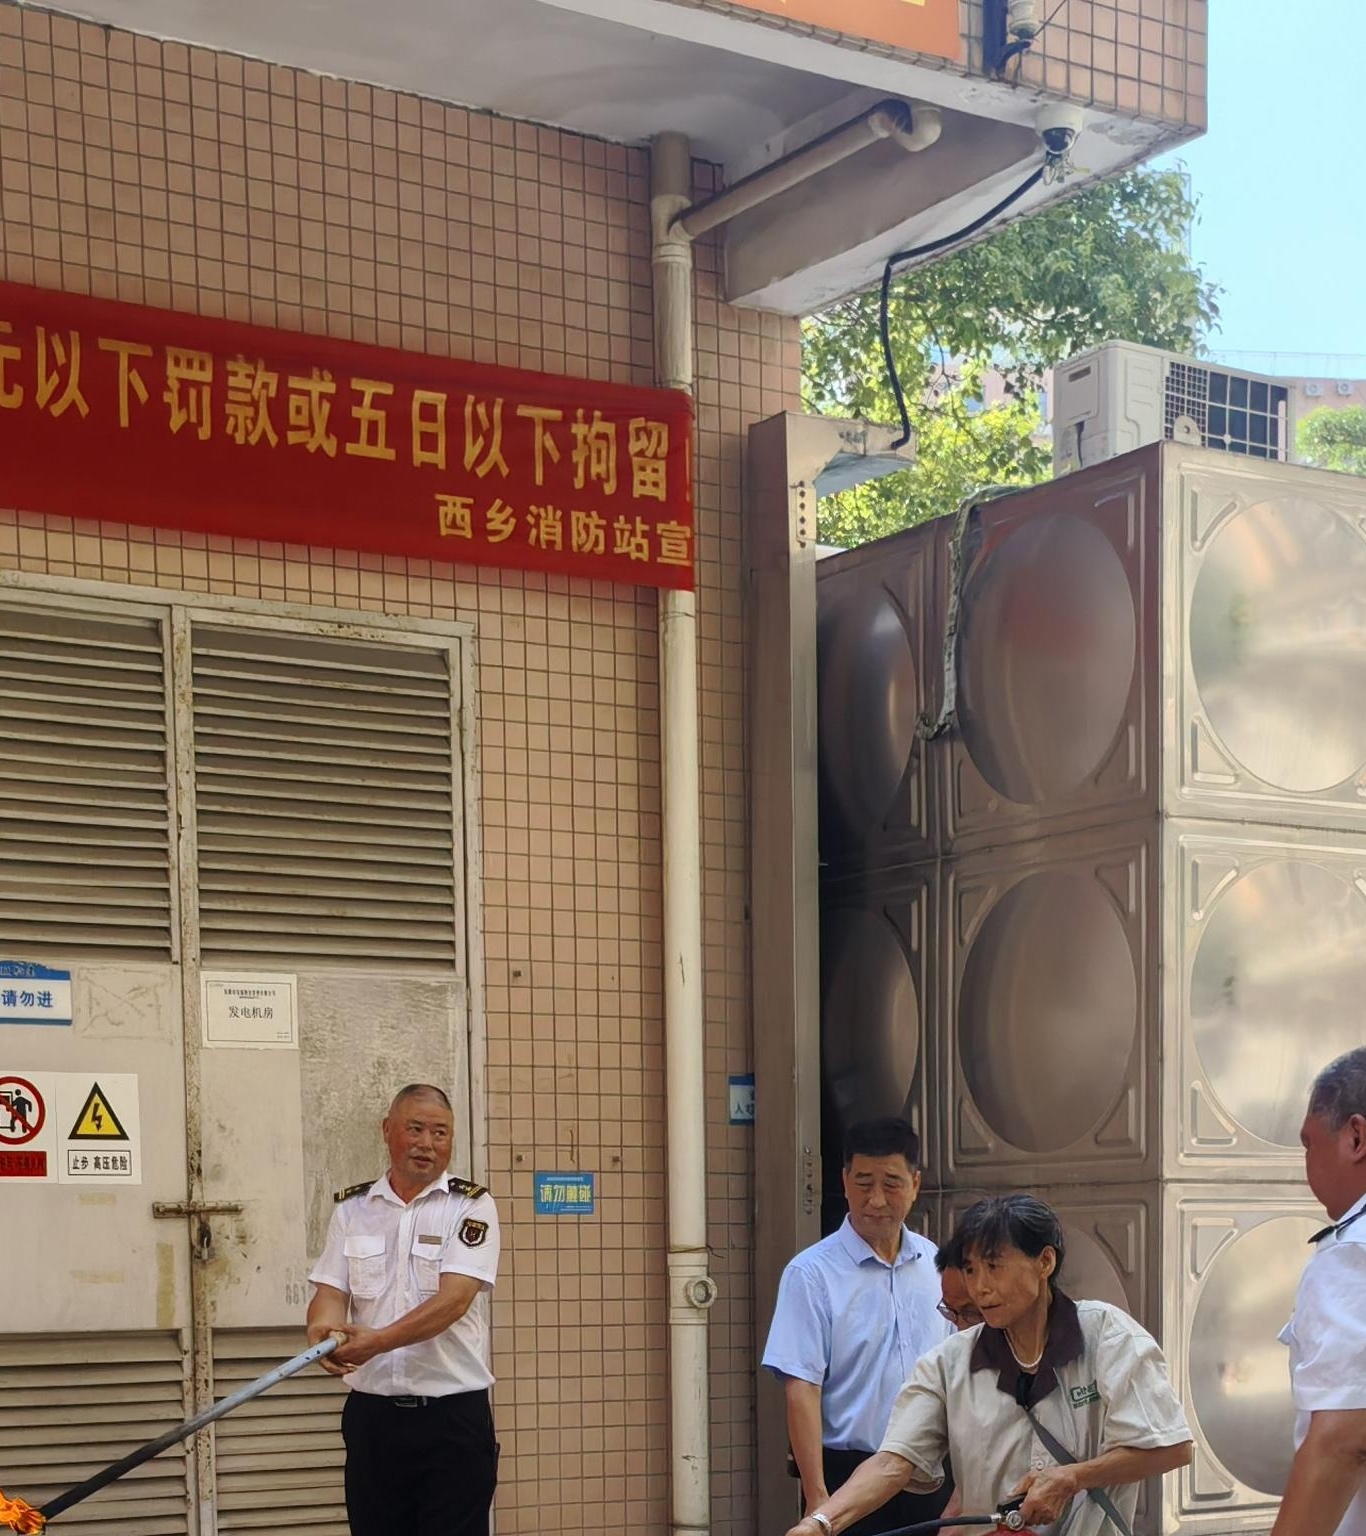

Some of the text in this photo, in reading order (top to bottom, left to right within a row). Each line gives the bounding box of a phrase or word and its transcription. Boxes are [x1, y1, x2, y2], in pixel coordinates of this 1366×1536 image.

[434, 492, 692, 568] 西乡消防站宣
[228, 1005, 274, 1020] 发电机房
[72, 1155, 128, 1171] 止步 高压危险
